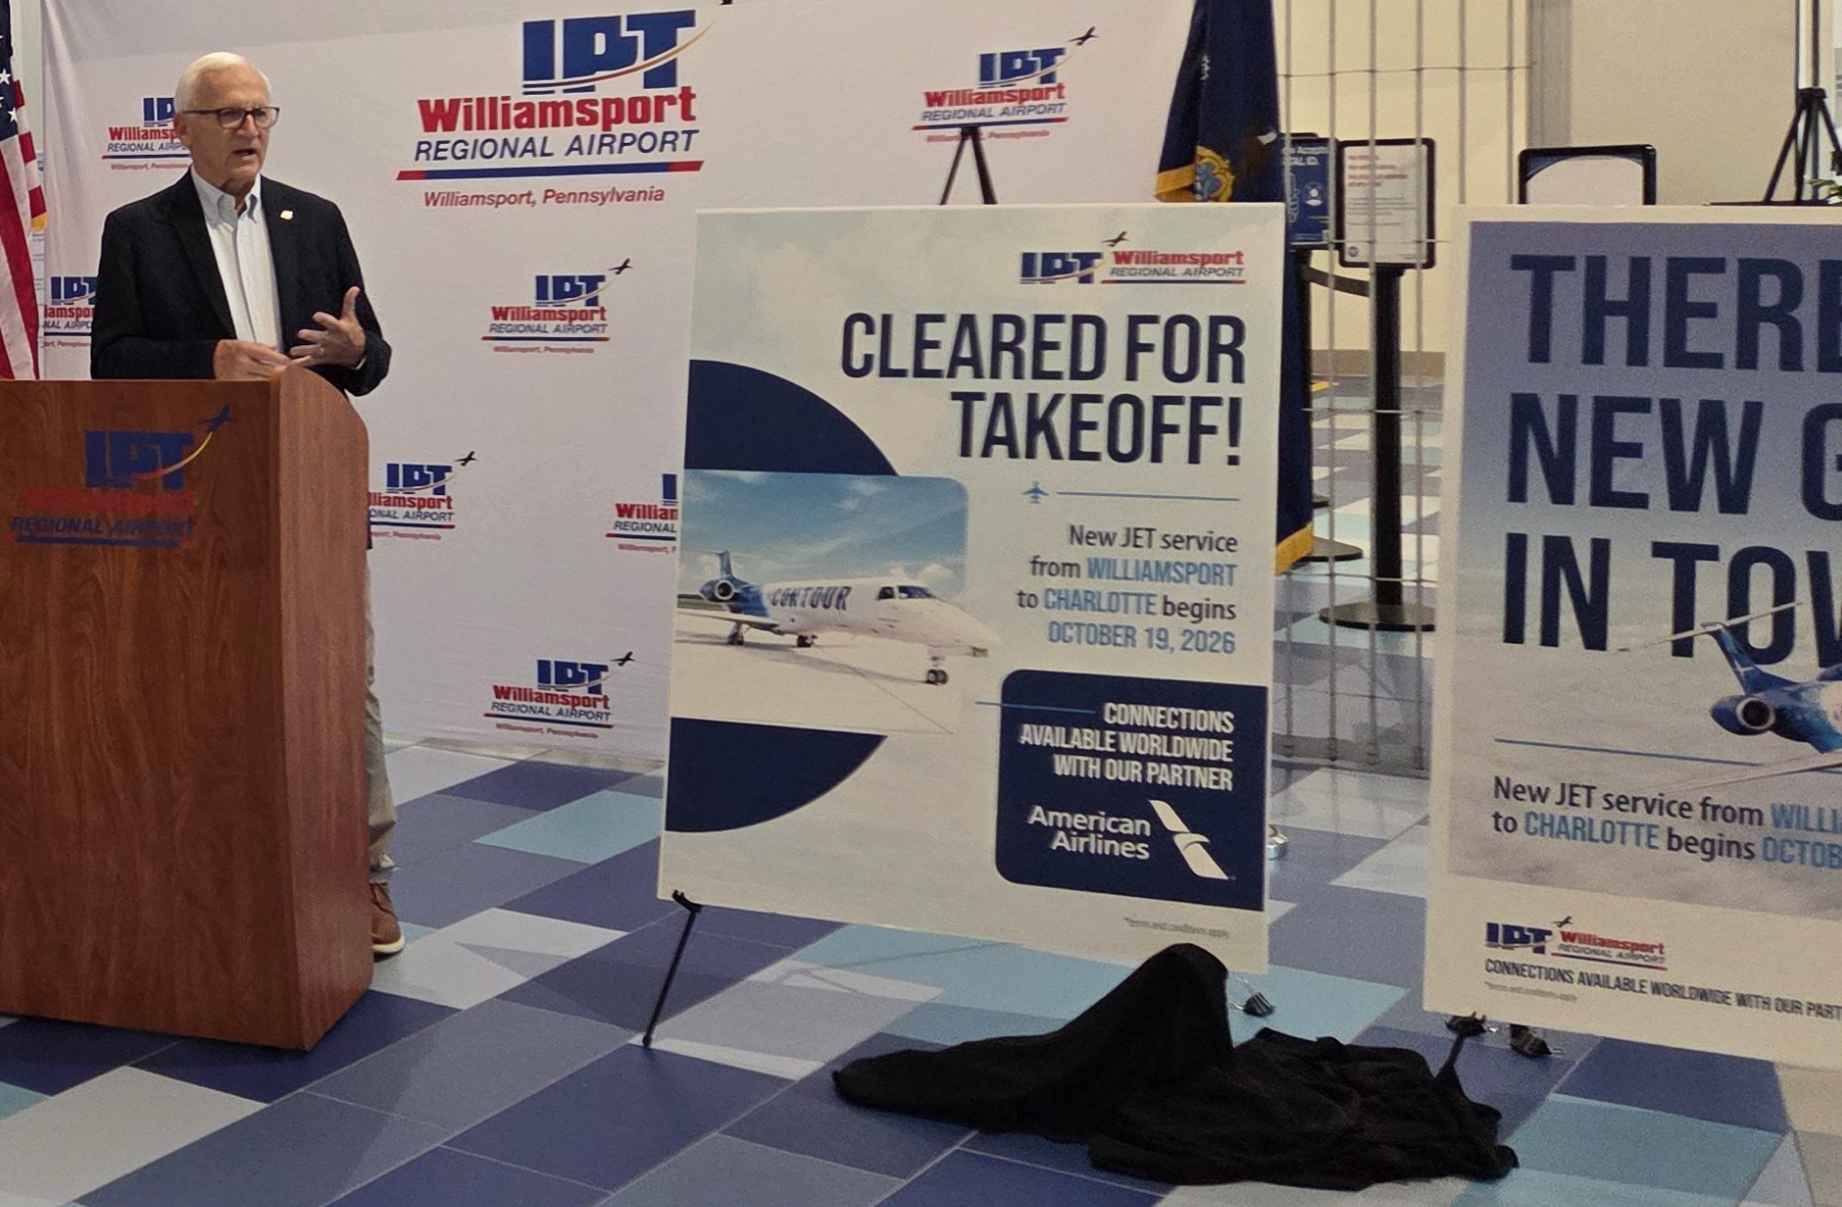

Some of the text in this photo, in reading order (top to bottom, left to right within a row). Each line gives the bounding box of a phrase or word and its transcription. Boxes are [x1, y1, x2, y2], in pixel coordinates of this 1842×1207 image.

[523, 9, 696, 96] IPT
[979, 47, 1066, 89] IPT
[417, 85, 697, 133] Williamsport
[924, 82, 1066, 108] Williamsport
[921, 102, 1068, 122] REGIONAL AIRPORT
[107, 142, 155, 152] REGIONAL
[414, 129, 700, 162] REGIONAL AIRPORT
[424, 185, 665, 209] Williamsport, Pennsylvania
[1020, 250, 1245, 285] IPT Williamsport
[1109, 267, 1246, 278] REGIONAL AIRPORT
[535, 275, 606, 307] IPT
[489, 323, 608, 334] REGIONAL AIRPORT
[491, 306, 607, 324] Williamsport
[840, 311, 1247, 384] CLEARED FOR
[950, 391, 1243, 467] TAKEOFF!
[1507, 392, 1764, 515] NEW
[386, 463, 452, 496] IPT
[11, 516, 103, 534] REGIONAL
[402, 510, 454, 522] AIRPORT
[613, 520, 677, 533] REGIONAL
[1069, 524, 1238, 553] New JET service
[1030, 555, 1238, 587] from WILLIAMSPORT
[1016, 588, 1237, 624] to CHARLOTTE begins
[1503, 532, 1612, 652] IN
[1047, 620, 1236, 655] OCTOBER 19, 2026
[537, 659, 609, 695] IPT
[491, 701, 611, 722] REGIONAL AIRPORT
[492, 685, 611, 710] Williamsport
[1104, 702, 1234, 734] CONNECTIONS
[1020, 723, 1234, 762] AVAILABLE WORLDWIDE
[1053, 754, 1234, 792] WITH OUR PARTNER
[1493, 775, 1551, 805] New
[1555, 782, 1597, 809] JET
[1602, 790, 1693, 820] service
[1698, 795, 1764, 827] from
[1028, 804, 1151, 837] American
[1492, 810, 1518, 835] to
[1524, 811, 1659, 850] CHARLOTTE
[1666, 828, 1756, 863] begins
[1051, 831, 1150, 861] Airlines
[1486, 922, 1665, 955] IPT Williamsport
[1558, 943, 1666, 965] REGIONAL AIRPORT
[1485, 958, 1574, 984] CONNECTIONS
[1577, 970, 1648, 994] AVAILABLE
[1650, 980, 1733, 1006] WORLDWIDE
[1735, 992, 1772, 1011] WITH
[1774, 997, 1803, 1016] OUR
